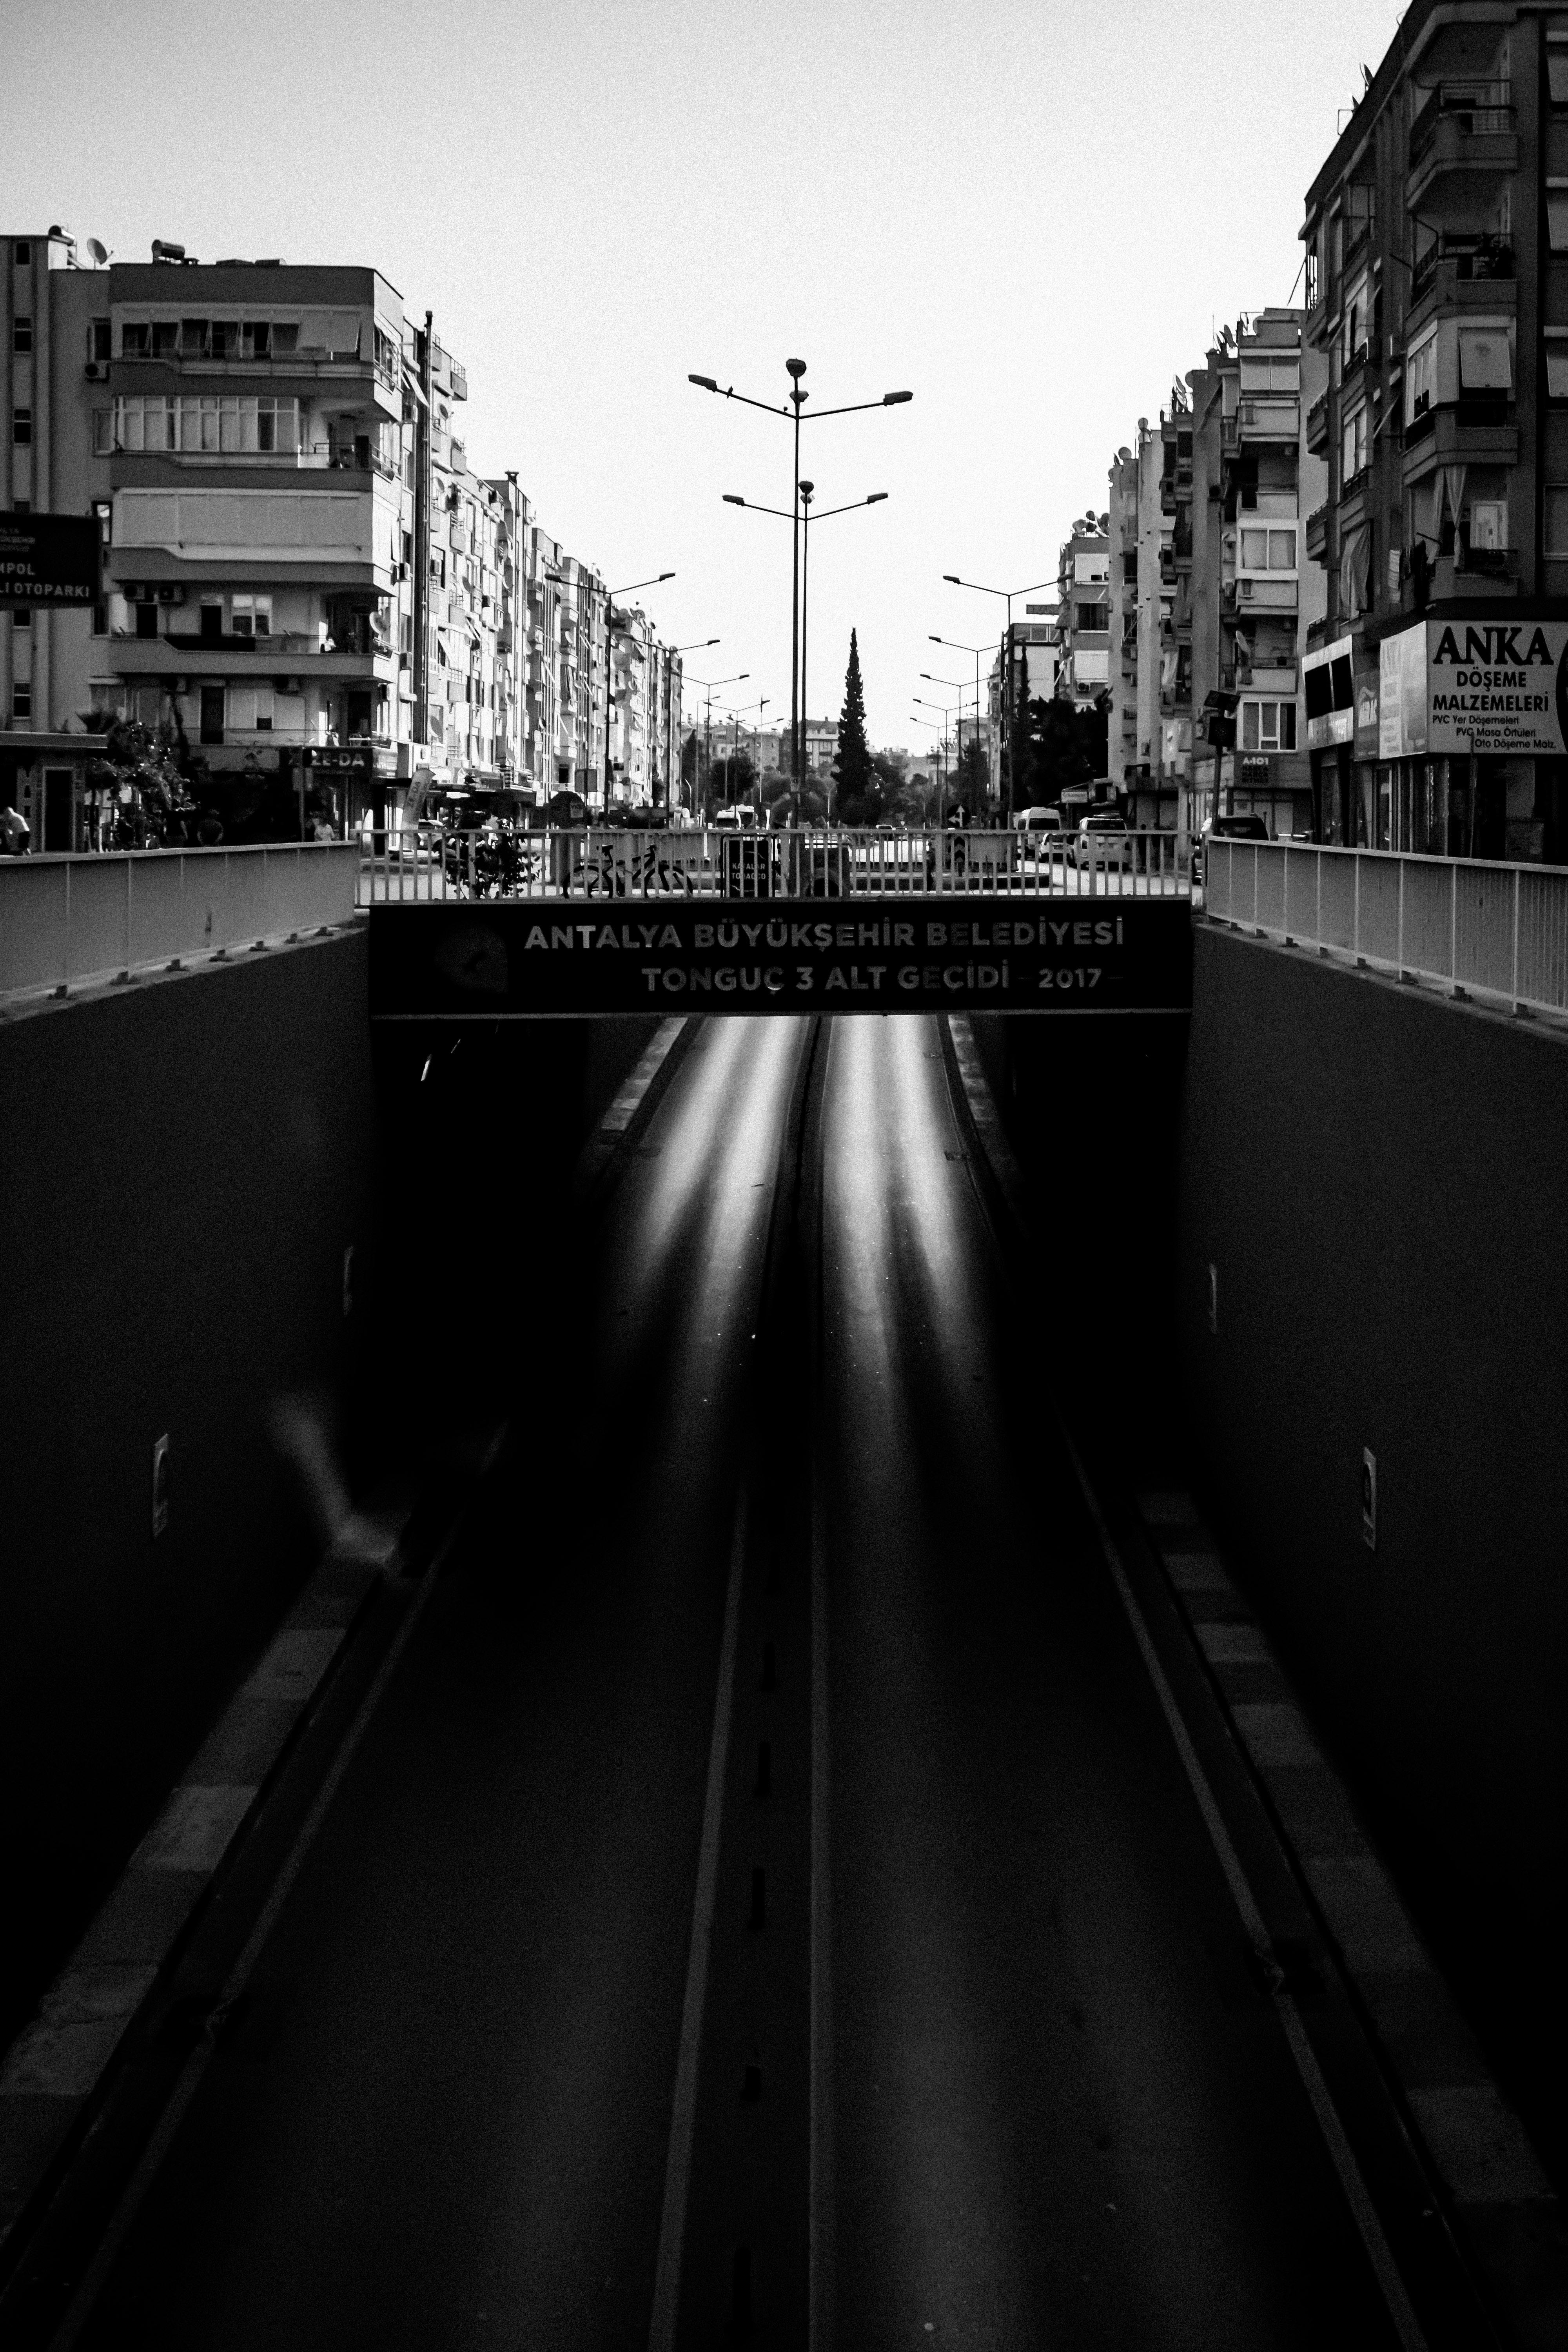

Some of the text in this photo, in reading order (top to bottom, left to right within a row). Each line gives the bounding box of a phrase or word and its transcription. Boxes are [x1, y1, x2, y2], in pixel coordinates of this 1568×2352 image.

[14, 582, 89, 597] OTOPARKI
[1433, 626, 1554, 665] ANKA
[1457, 667, 1526, 691] DÖŞEME
[1433, 691, 1548, 711] MALZEMELERİ
[1432, 715, 1519, 726] PVC Yer Döşemeleri
[1456, 728, 1474, 736] PVC
[1477, 728, 1501, 737] Masa
[1475, 739, 1491, 748] Oto
[1494, 739, 1530, 750] Döşeme
[524, 916, 1123, 952] ANTALYA BÜYÜKŞEHİR BELEDİYESİ
[642, 959, 1102, 995] TONGUÇ 3 ALT GEÇİDİ 2017
